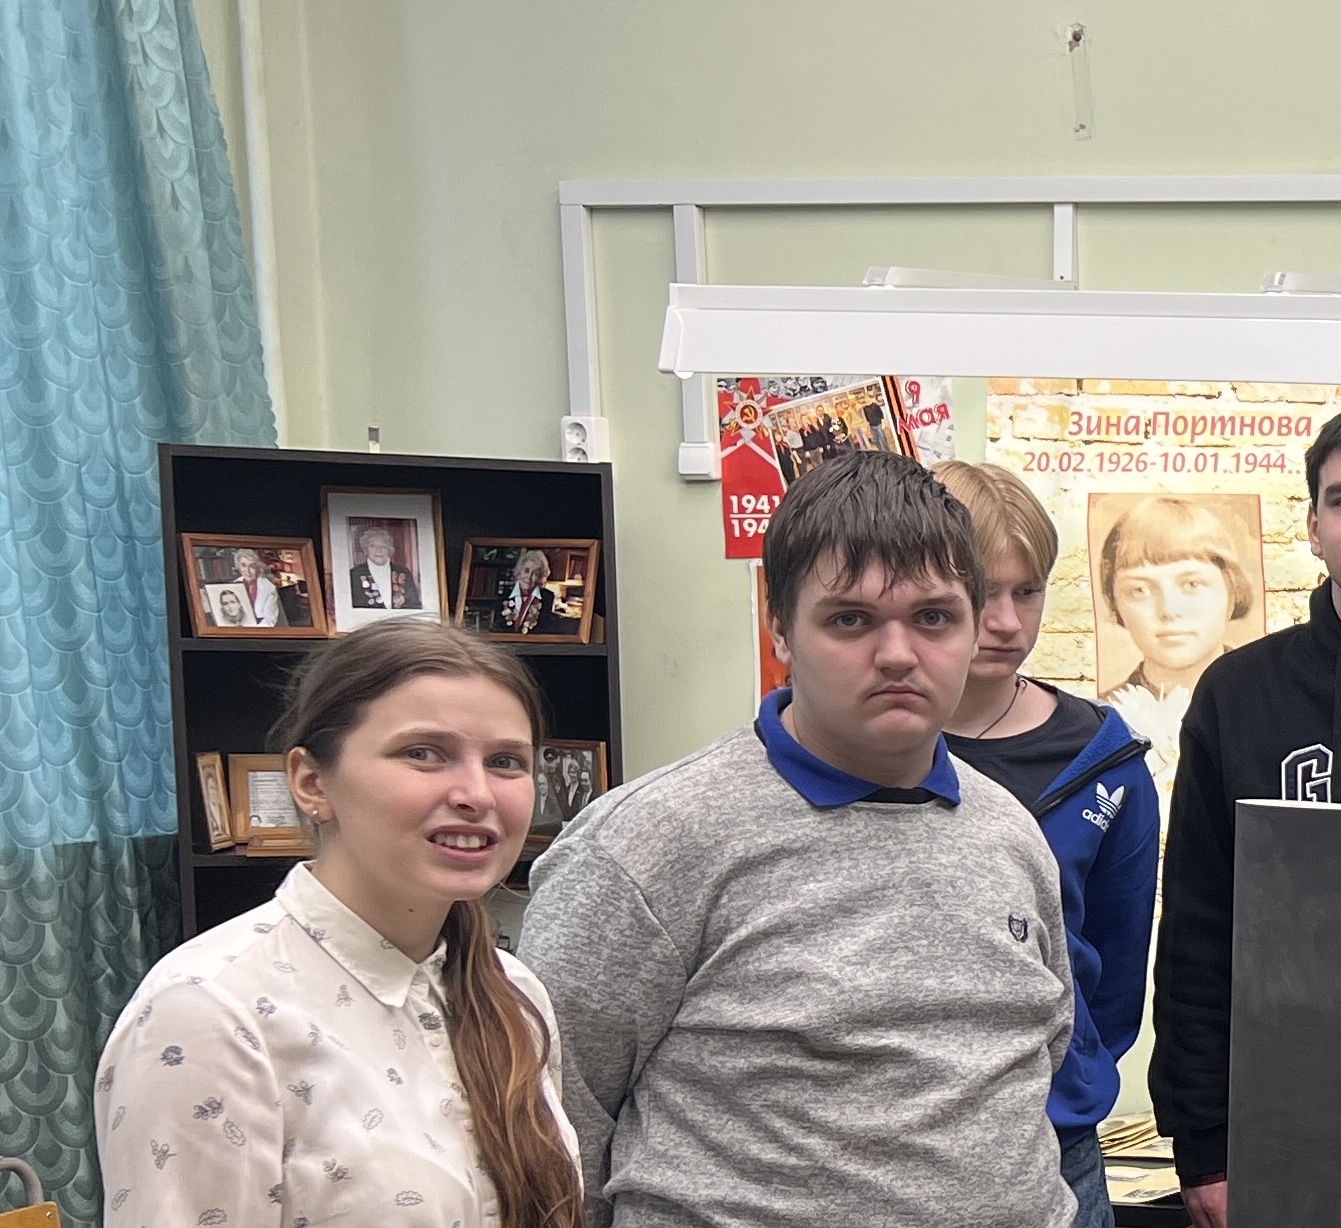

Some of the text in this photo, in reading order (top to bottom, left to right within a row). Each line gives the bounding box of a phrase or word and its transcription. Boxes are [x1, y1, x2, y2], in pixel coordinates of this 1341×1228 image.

[1068, 411, 1313, 443] Зина Портнова
[729, 494, 780, 514] 1941
[731, 518, 770, 538] 194
[1082, 808, 1111, 833] adid
